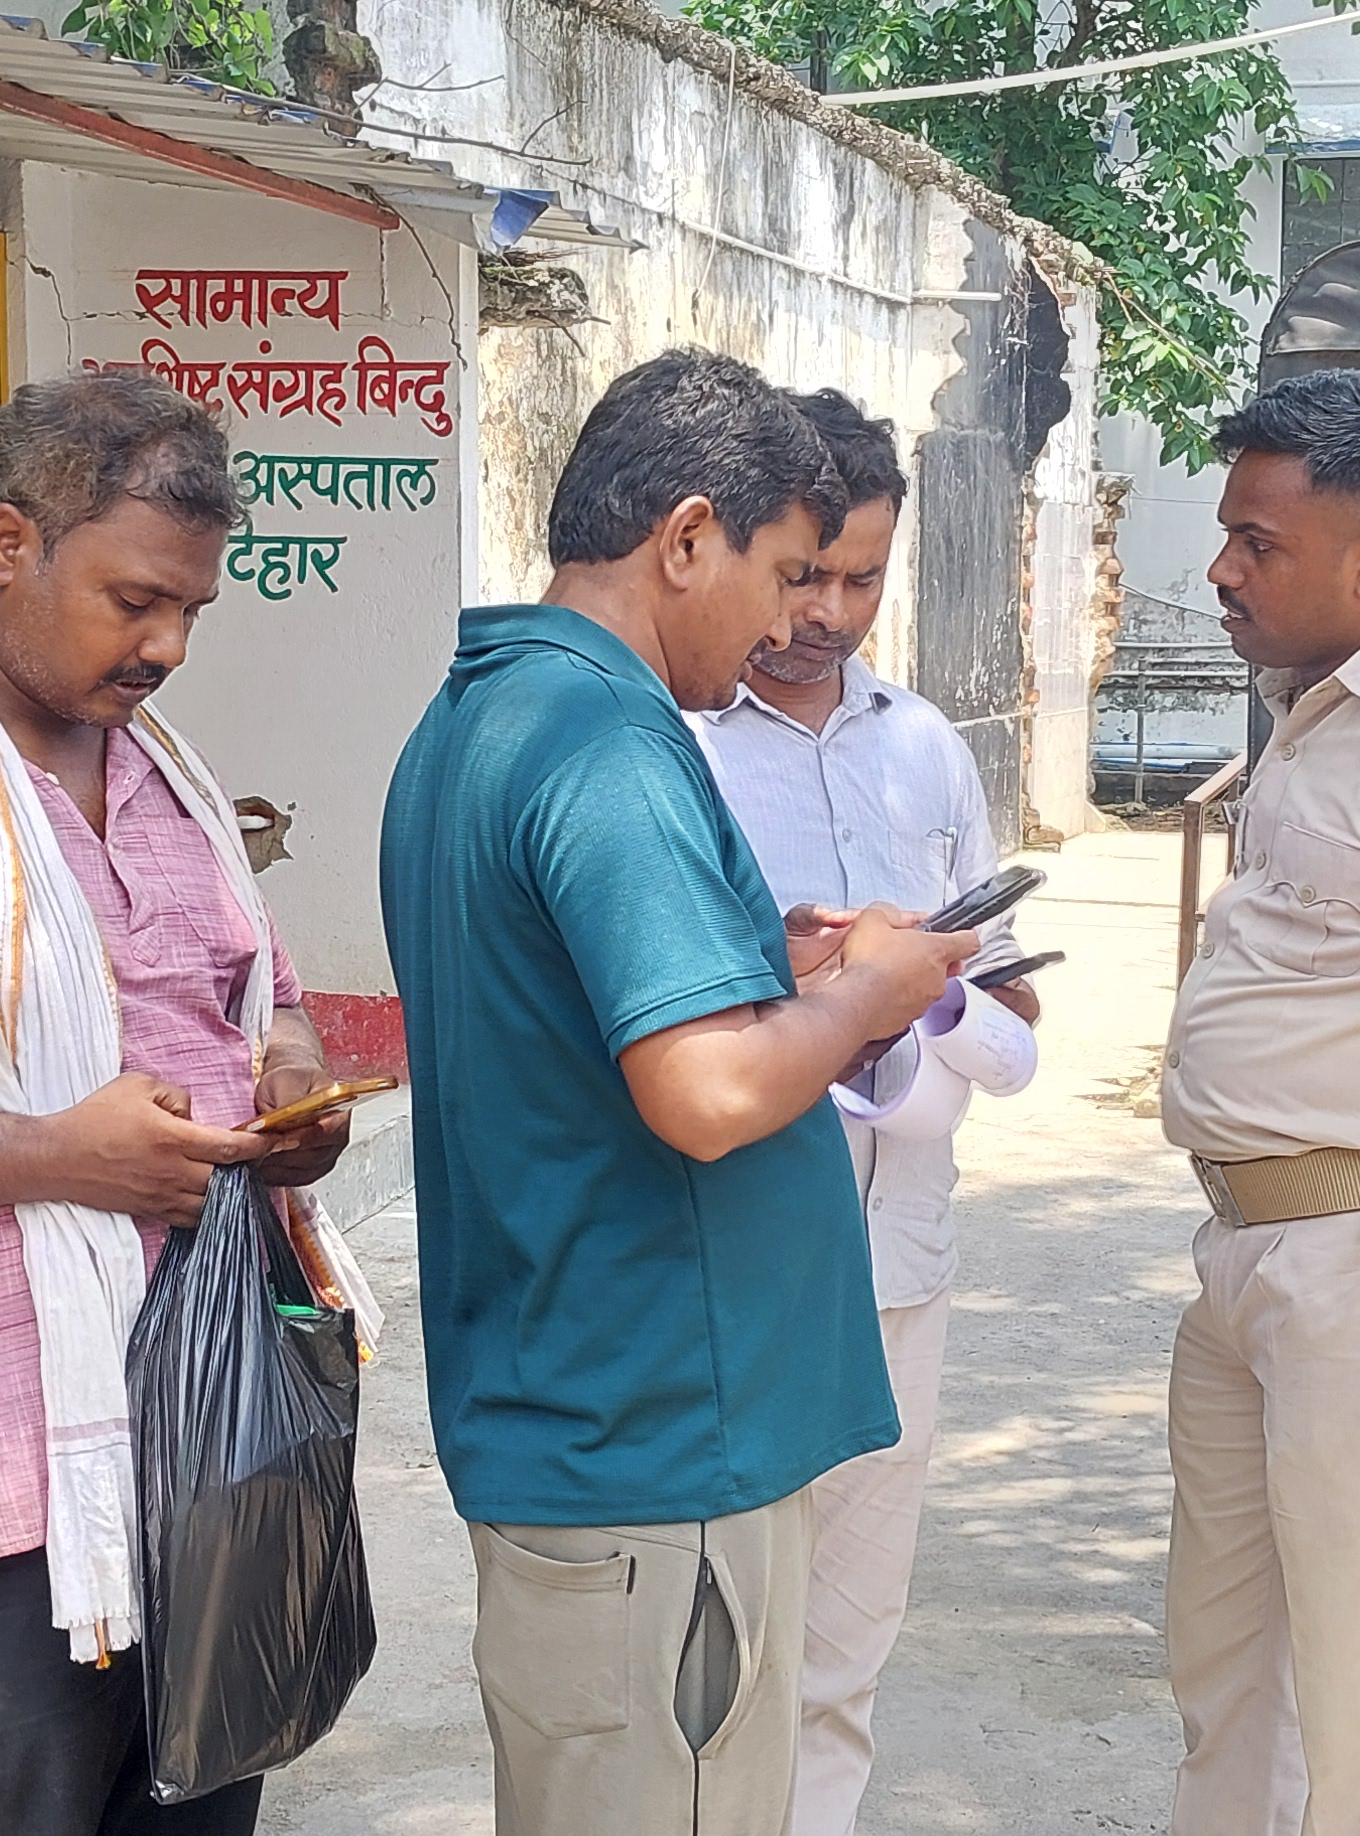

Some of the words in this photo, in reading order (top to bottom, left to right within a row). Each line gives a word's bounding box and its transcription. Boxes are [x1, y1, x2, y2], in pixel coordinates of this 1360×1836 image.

[135, 269, 349, 331] सामान्य
[227, 340, 348, 427] संग्रह
[352, 335, 453, 437] बिन्दु
[232, 450, 439, 512] अस्पताल
